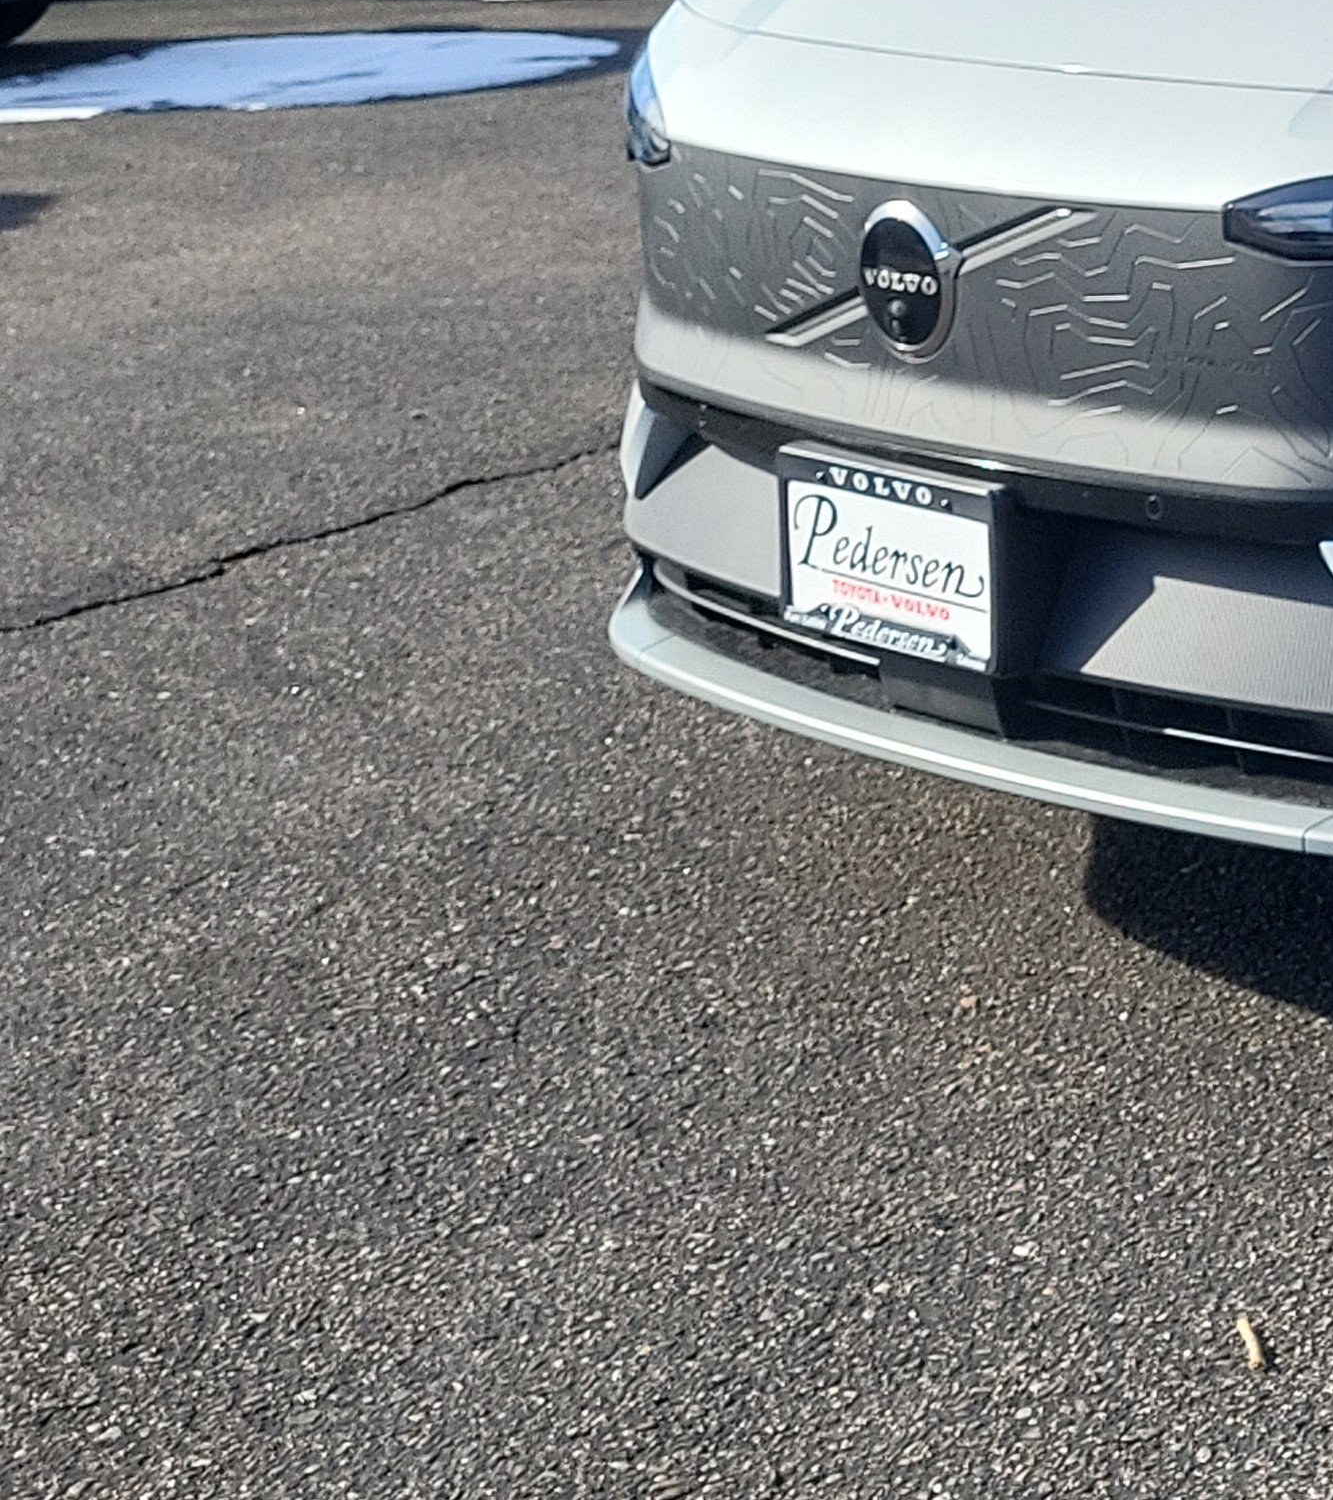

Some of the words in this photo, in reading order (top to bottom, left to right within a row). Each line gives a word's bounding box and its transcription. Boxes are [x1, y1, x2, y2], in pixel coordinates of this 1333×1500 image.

[862, 267, 939, 296] VOLVO
[828, 465, 933, 505] VOLVO
[794, 493, 985, 598] Pedersen
[829, 604, 948, 658] Pedersen
